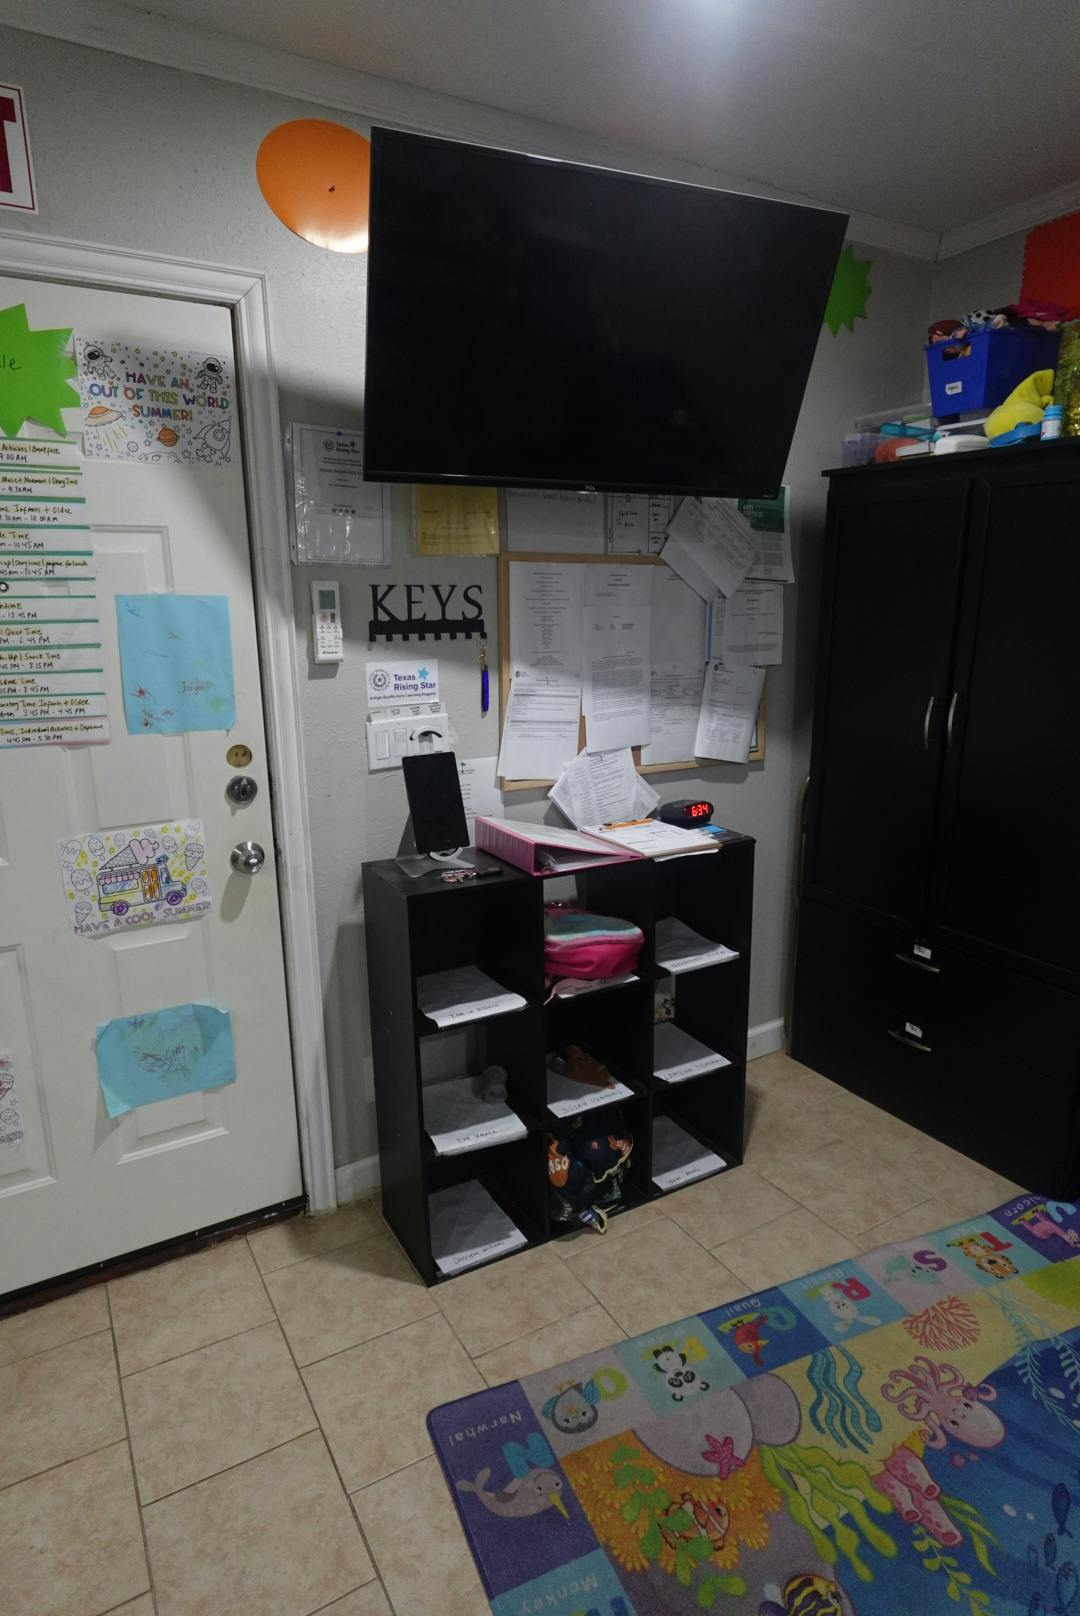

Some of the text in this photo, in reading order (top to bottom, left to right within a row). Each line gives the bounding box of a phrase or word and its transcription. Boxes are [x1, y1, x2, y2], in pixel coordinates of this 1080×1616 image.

[126, 371, 190, 390] HAVE AN
[89, 383, 230, 410] OUT OF THIS WORLD
[132, 404, 194, 422] SUMMER!
[8, 530, 30, 540] Time
[33, 541, 45, 549] AM
[368, 583, 483, 622] KEYS
[27, 611, 38, 619] PM
[24, 627, 43, 635] Time
[38, 635, 50, 643] PM
[393, 674, 416, 682] Texas
[393, 682, 437, 692] Rising Star
[691, 803, 709, 817] 6:34
[73, 920, 110, 936] HAVE
[113, 916, 123, 927] A
[125, 910, 157, 926] COOL
[832, 1276, 872, 1301] R
[725, 1298, 762, 1318] Quail
[448, 1410, 523, 1447] Narwhal
[502, 1432, 555, 1479] N
[521, 1573, 599, 1616] Monkey
